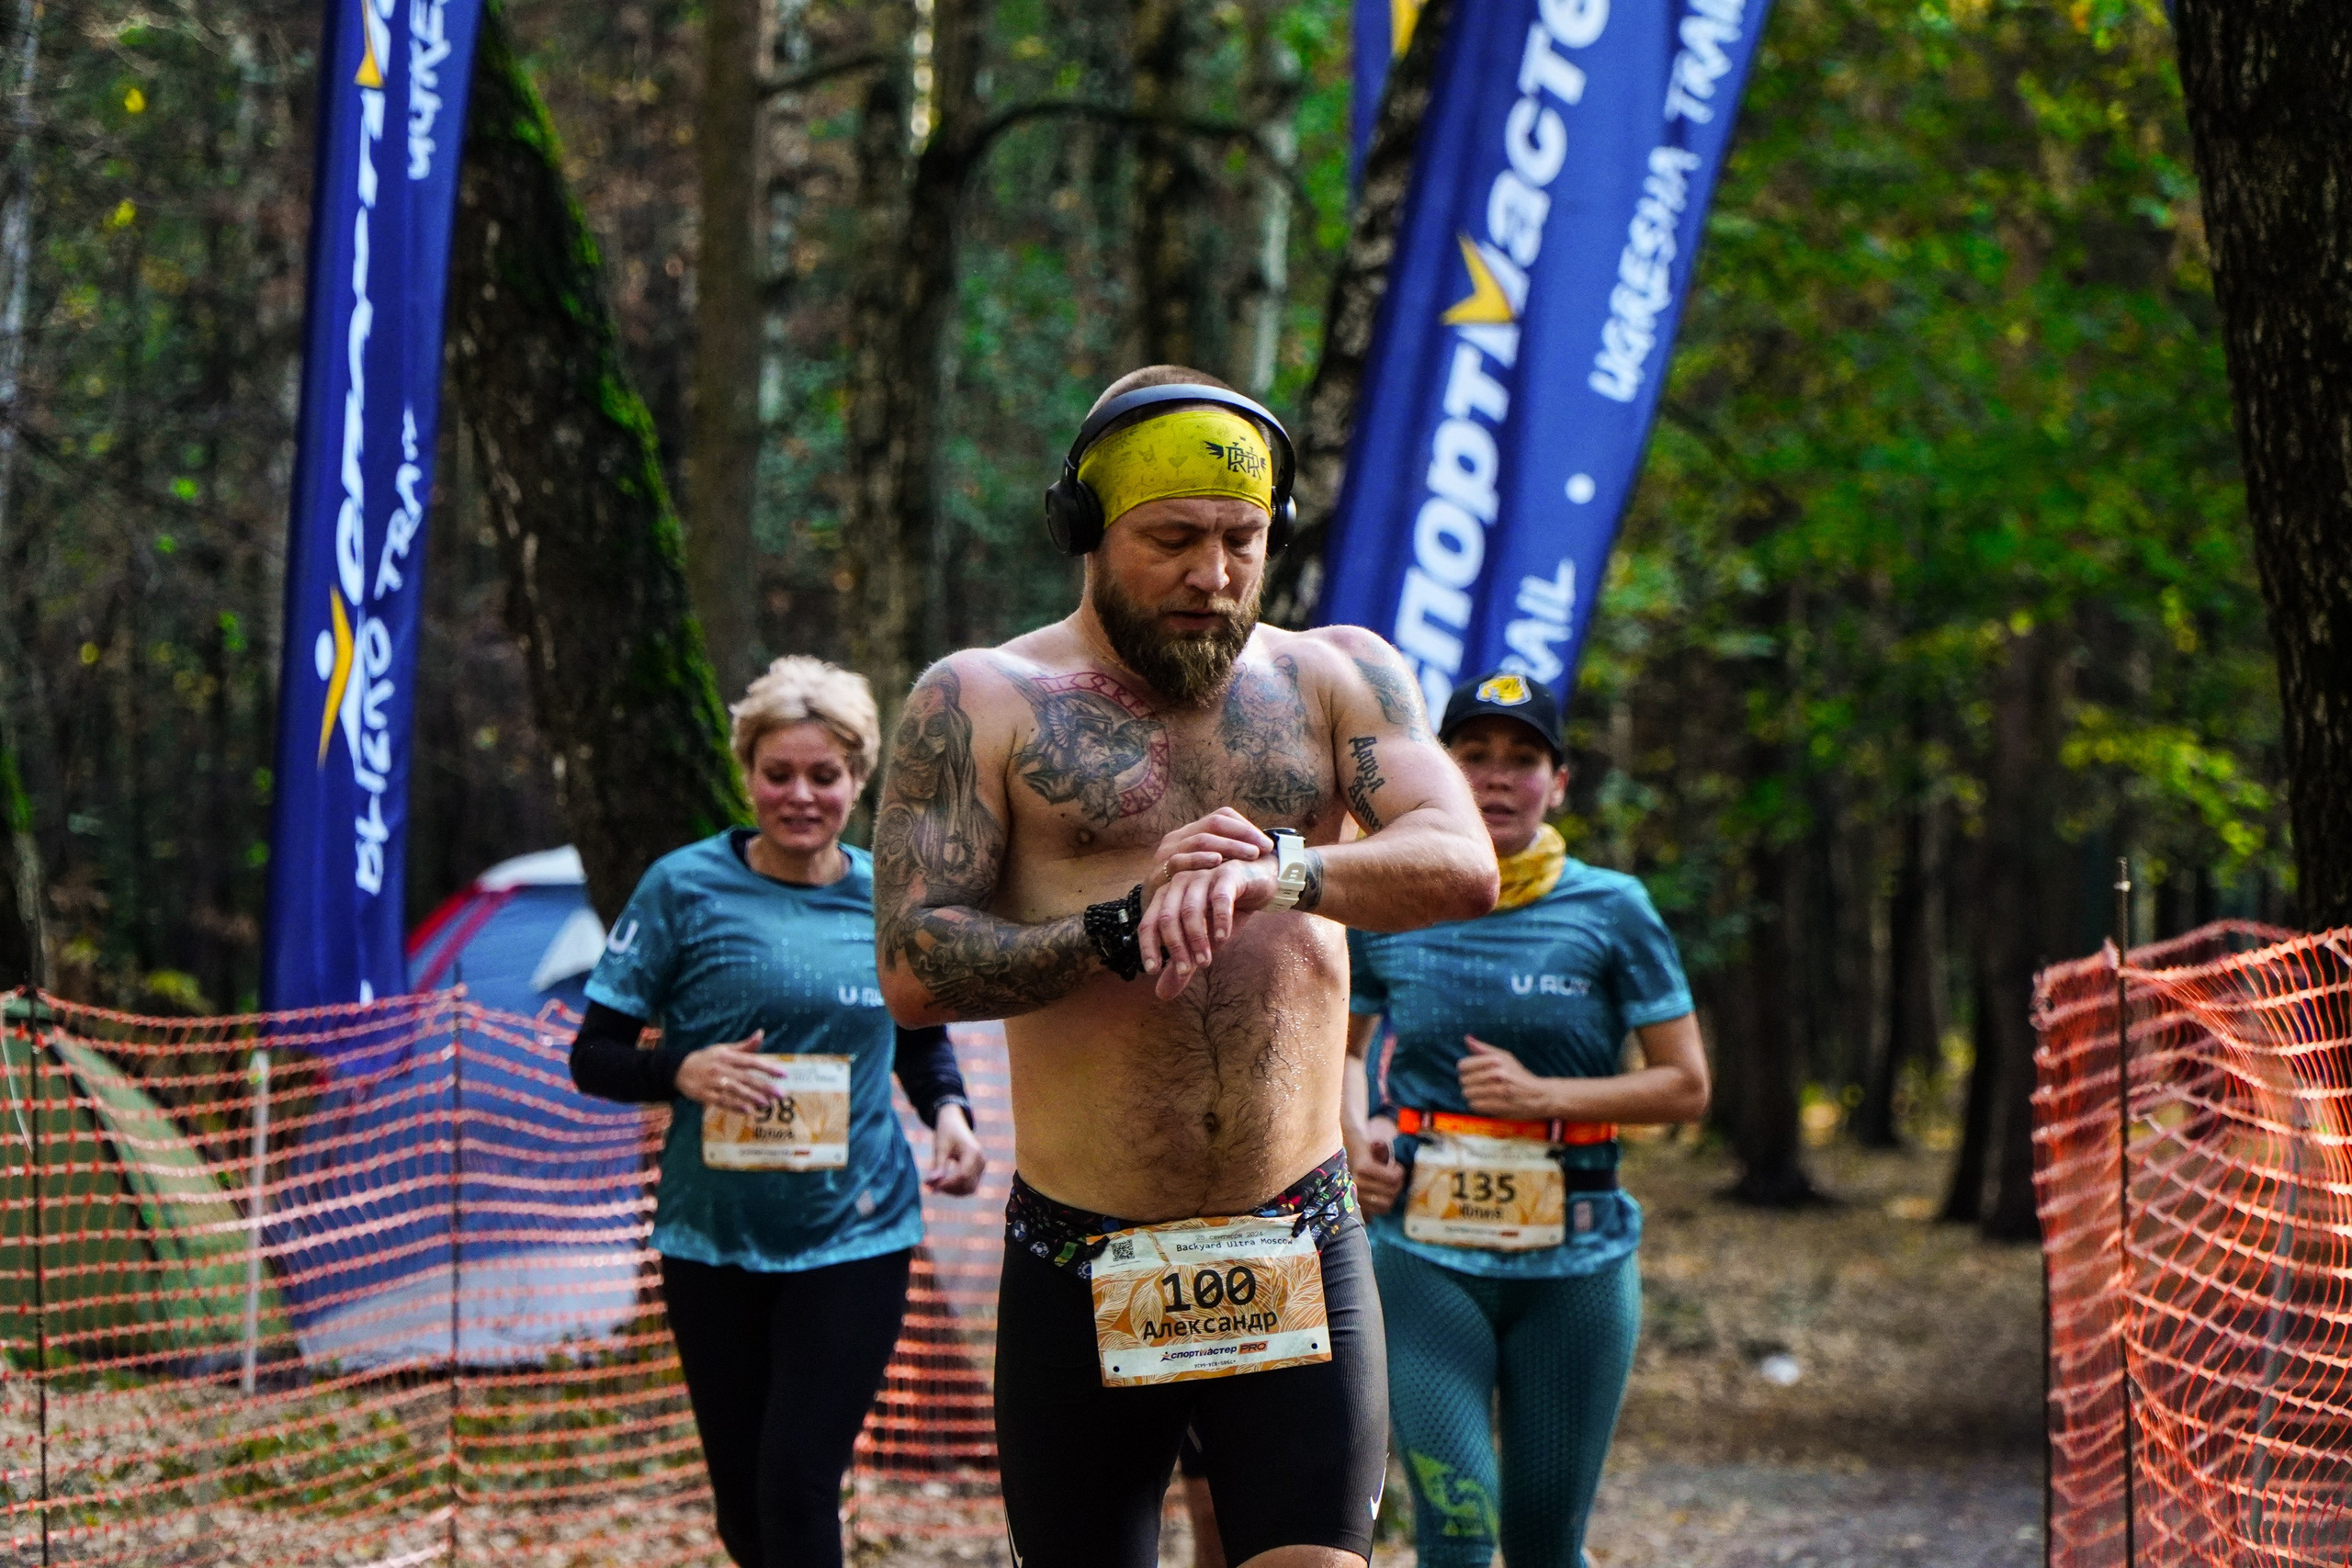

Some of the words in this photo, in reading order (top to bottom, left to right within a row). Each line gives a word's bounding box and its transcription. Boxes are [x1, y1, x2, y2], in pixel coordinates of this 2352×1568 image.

[1589, 145, 1702, 402] UGRESHA
[1451, 1170, 1516, 1203] 135
[1176, 1242, 1222, 1252] Backyard
[1227, 1240, 1256, 1248] Ultra
[1161, 1266, 1257, 1314] 100
[1142, 1309, 1278, 1340] Александр
[1239, 1342, 1267, 1353] PRO
